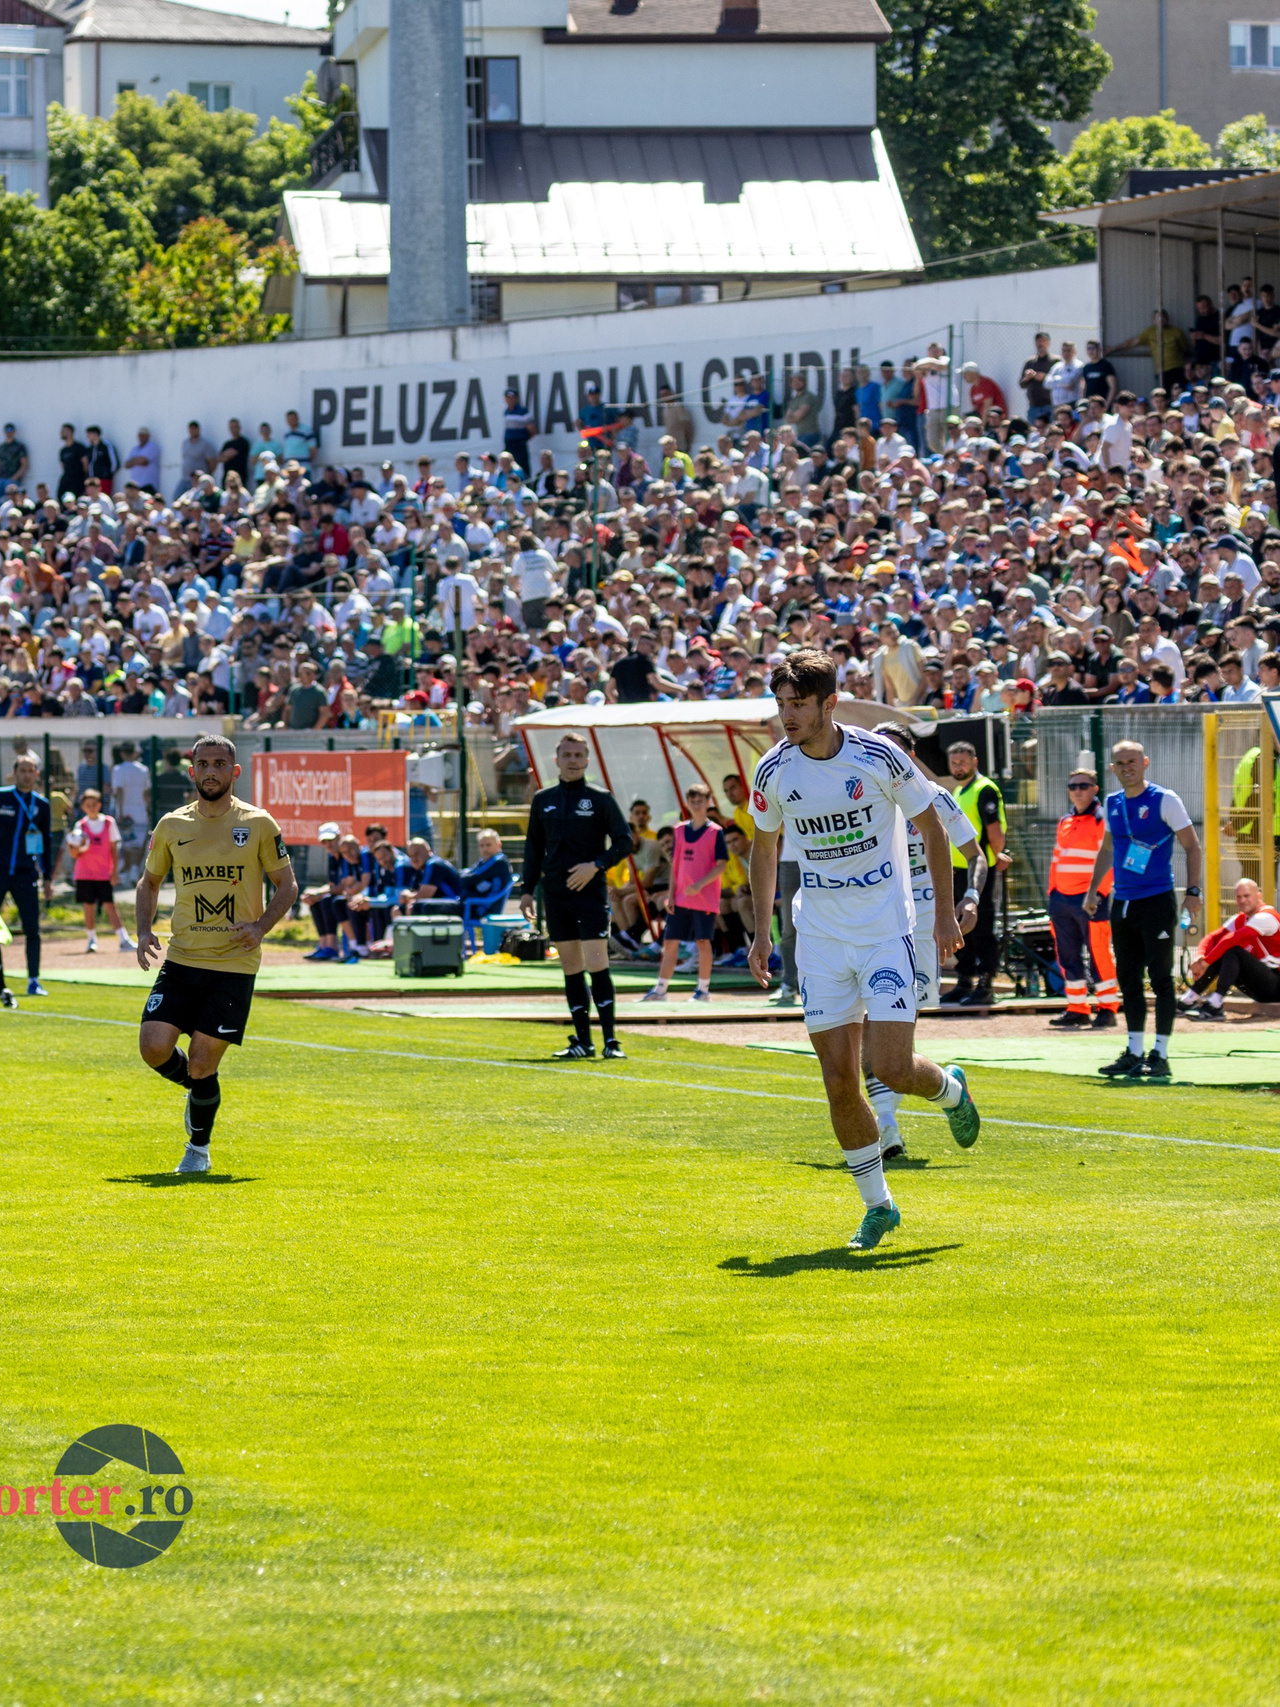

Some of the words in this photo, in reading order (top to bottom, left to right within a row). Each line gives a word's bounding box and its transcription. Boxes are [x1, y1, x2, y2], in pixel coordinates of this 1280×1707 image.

[313, 378, 491, 447] PELUZA
[795, 804, 875, 836] UNIBET
[842, 843, 863, 856] SPRE
[181, 865, 245, 882] MAXBET
[803, 860, 894, 890] ELSACO
[190, 925, 229, 933] METROPOLA
